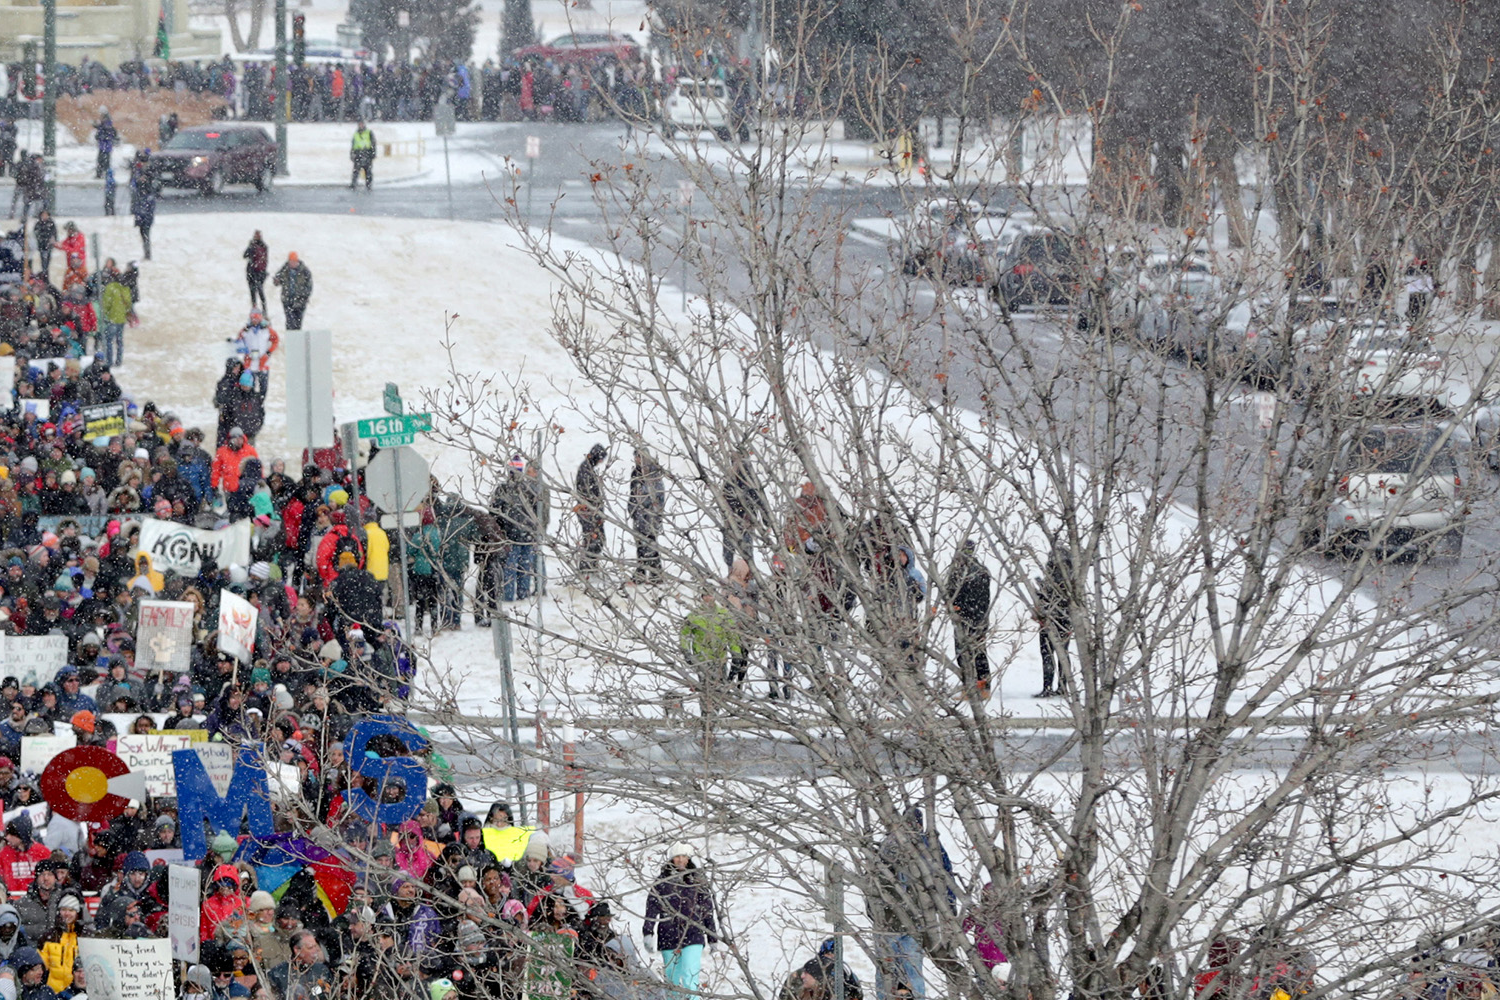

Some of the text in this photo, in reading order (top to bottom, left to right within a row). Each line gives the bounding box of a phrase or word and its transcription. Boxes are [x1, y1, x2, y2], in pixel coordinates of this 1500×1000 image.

[368, 418, 403, 436] 16th
[152, 533, 223, 563] KGNU
[141, 606, 191, 628] FAMILY
[119, 736, 143, 754] Sex
[145, 735, 177, 753] When
[130, 756, 164, 767] Desire
[170, 877, 197, 889] TRUMP
[170, 913, 196, 928] CRISIS
[136, 944, 156, 954] tried
[119, 958, 127, 967] to
[130, 959, 149, 970] bury
[121, 970, 138, 982] They
